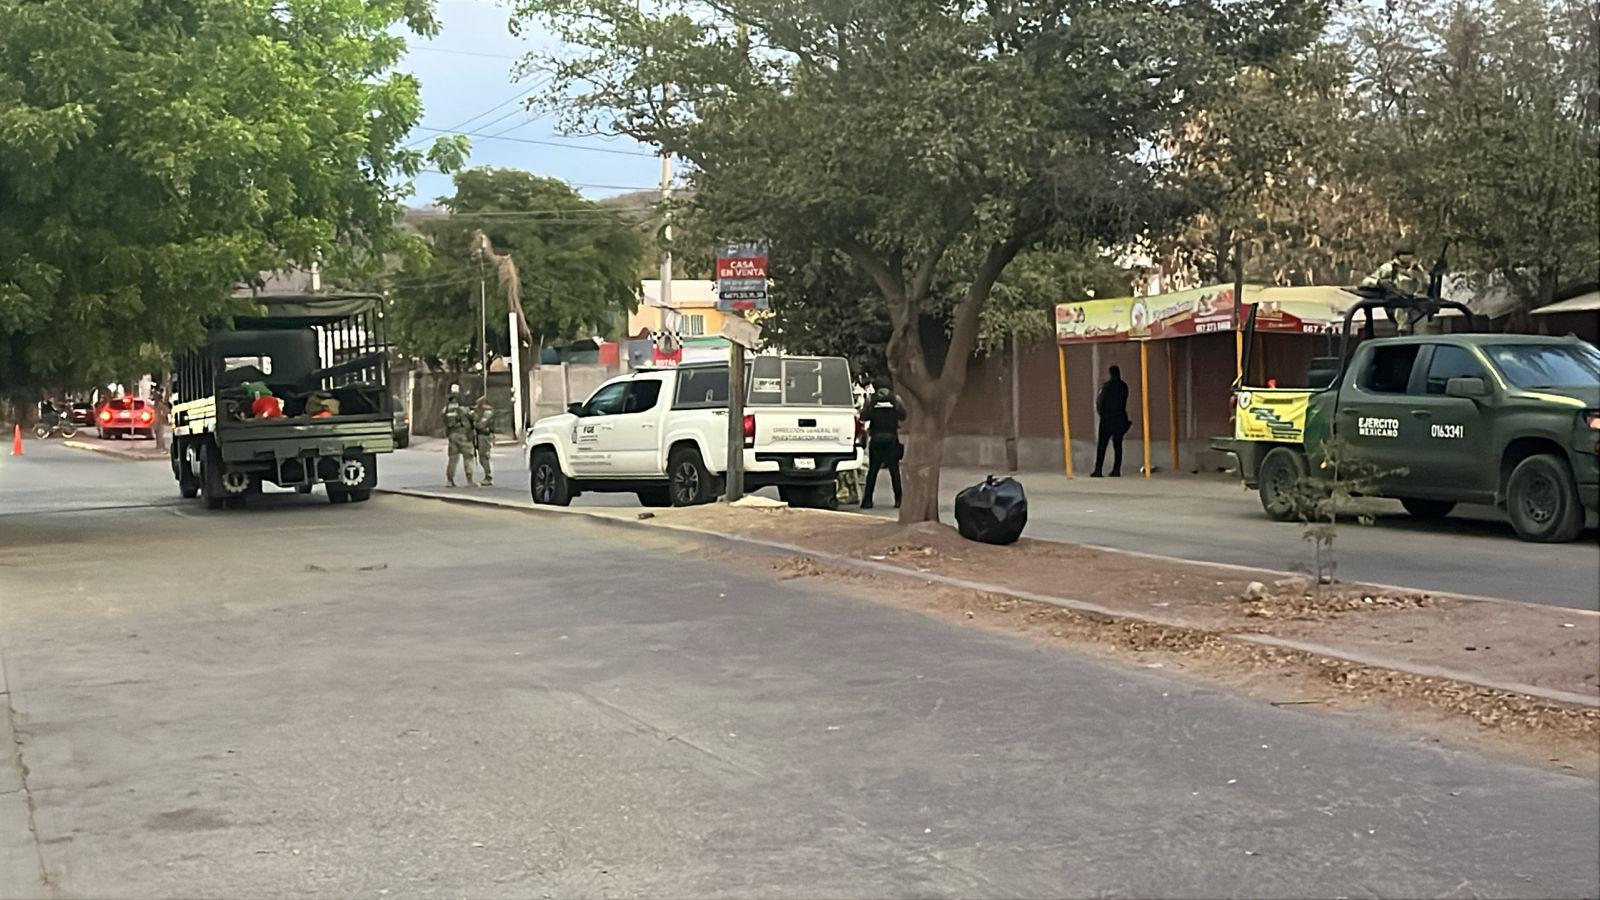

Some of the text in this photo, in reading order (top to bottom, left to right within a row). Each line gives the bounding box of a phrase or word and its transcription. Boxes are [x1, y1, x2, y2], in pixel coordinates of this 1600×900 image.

[730, 261, 754, 269] CASA
[720, 268, 765, 277] EN VENTA
[1358, 417, 1399, 429] EJERCITO
[1359, 427, 1398, 437] MEXICANO
[1431, 424, 1464, 438] 0163341
